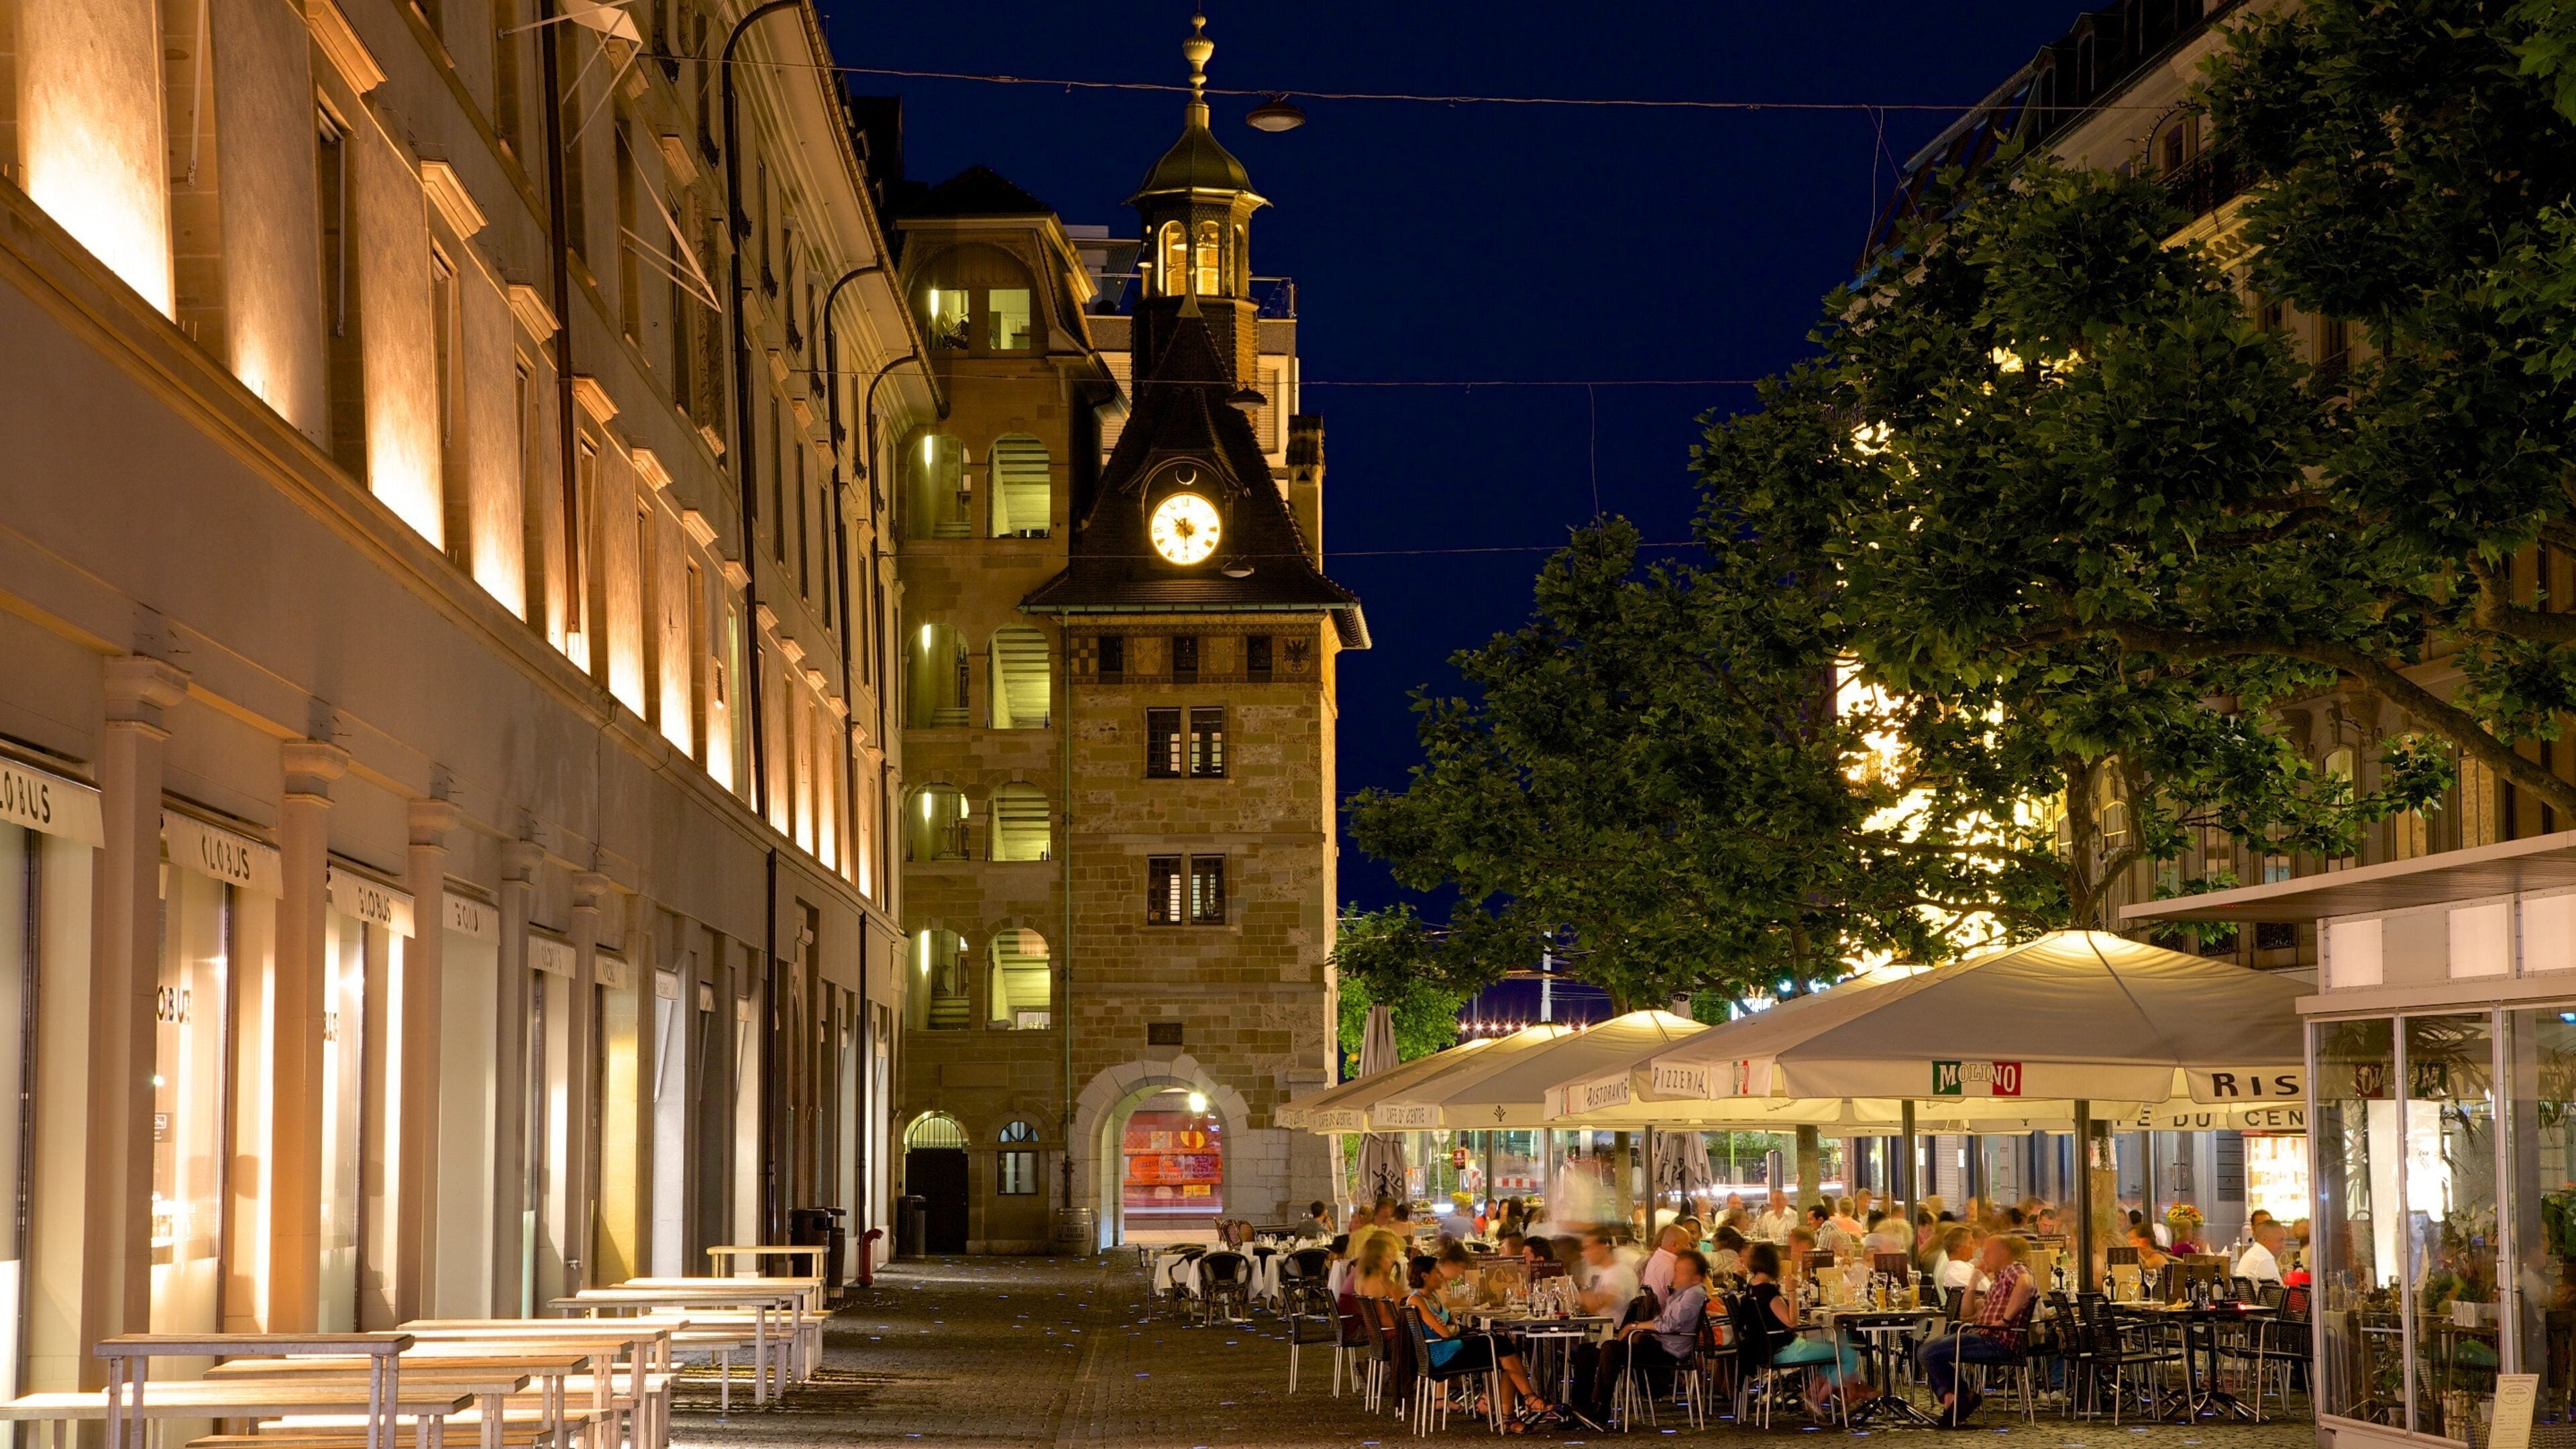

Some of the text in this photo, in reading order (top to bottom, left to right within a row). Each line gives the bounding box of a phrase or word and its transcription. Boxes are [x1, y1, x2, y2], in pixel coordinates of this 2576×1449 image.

[0, 771, 50, 824] OBUS
[1587, 1077, 1627, 1106] RISTORANTE
[1654, 1067, 1705, 1093] PIZZERIA
[1939, 1064, 2016, 1093] MOLINO
[2212, 1073, 2300, 1097] RIS
[2174, 1113, 2211, 1127] DU
